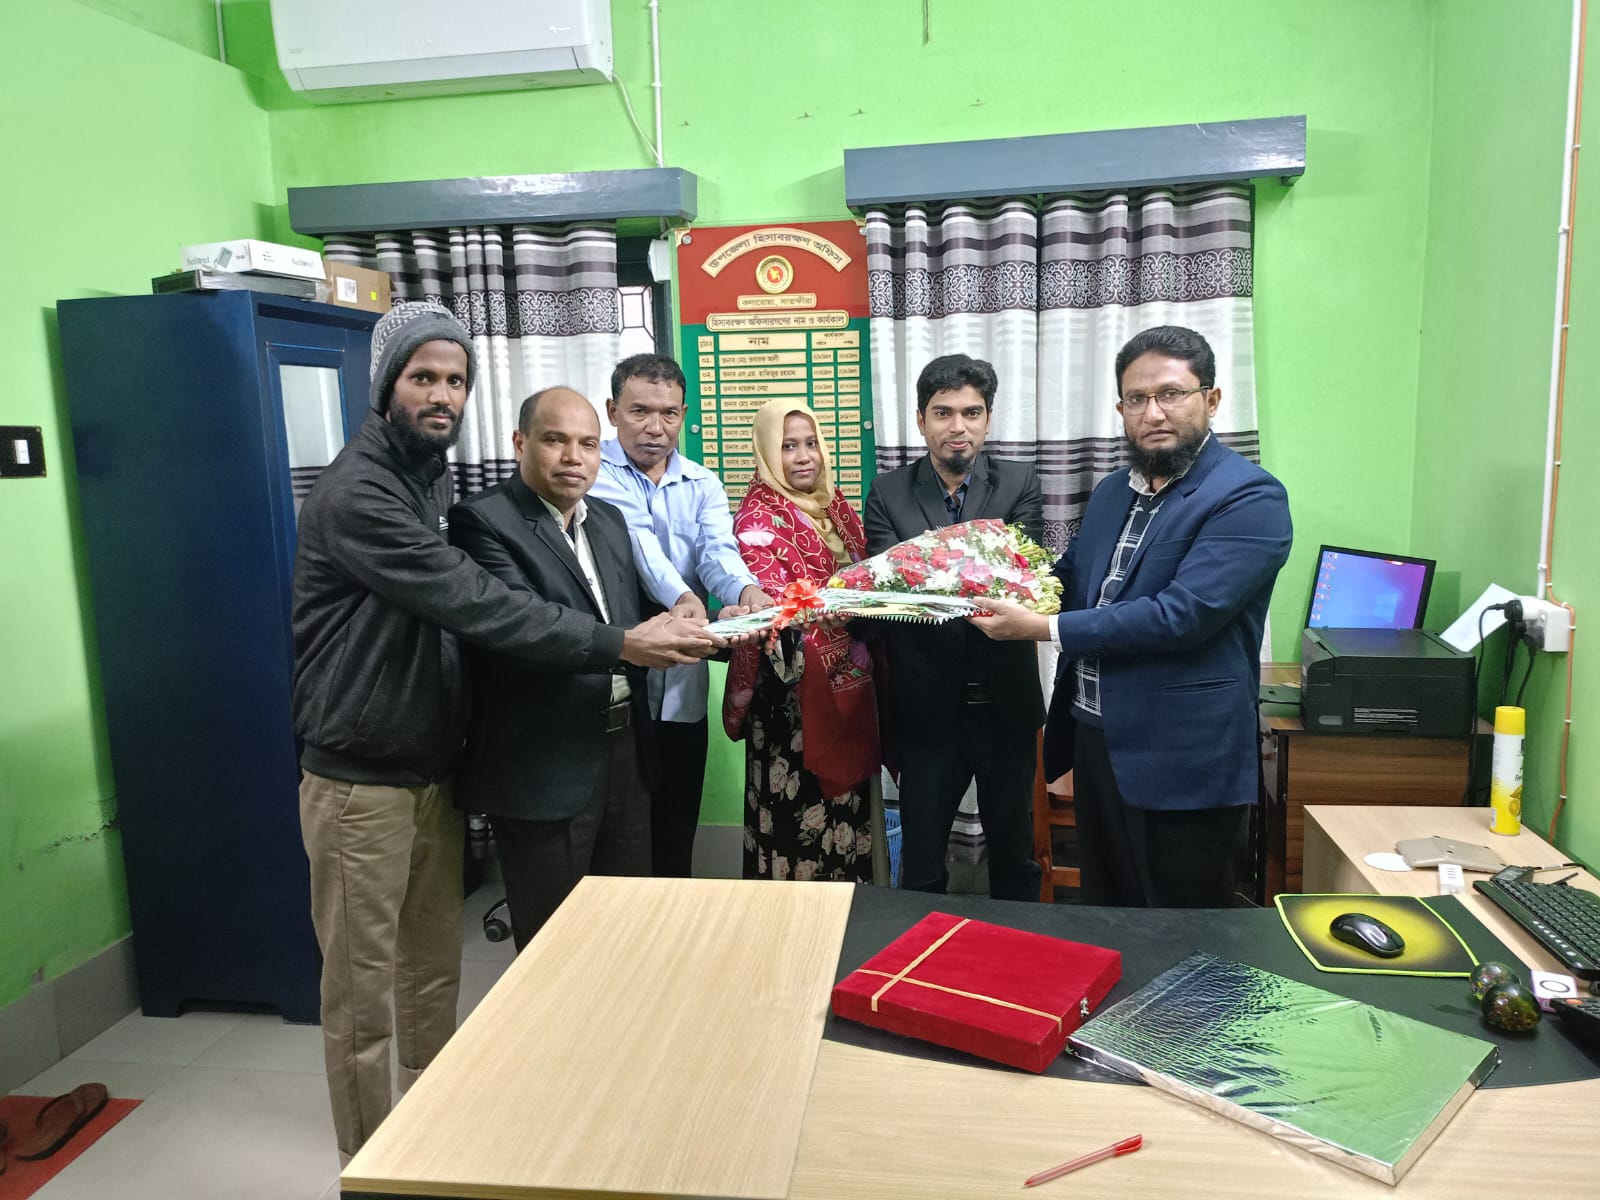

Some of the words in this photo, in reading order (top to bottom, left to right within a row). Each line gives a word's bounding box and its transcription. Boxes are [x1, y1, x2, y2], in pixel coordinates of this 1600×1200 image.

[753, 233, 811, 246] হিসাবরক্ষণ
[813, 241, 844, 264] অফিস
[711, 317, 746, 327] হিসাবরক্ষণ
[793, 316, 806, 325] নাম
[748, 337, 769, 346] নাম
